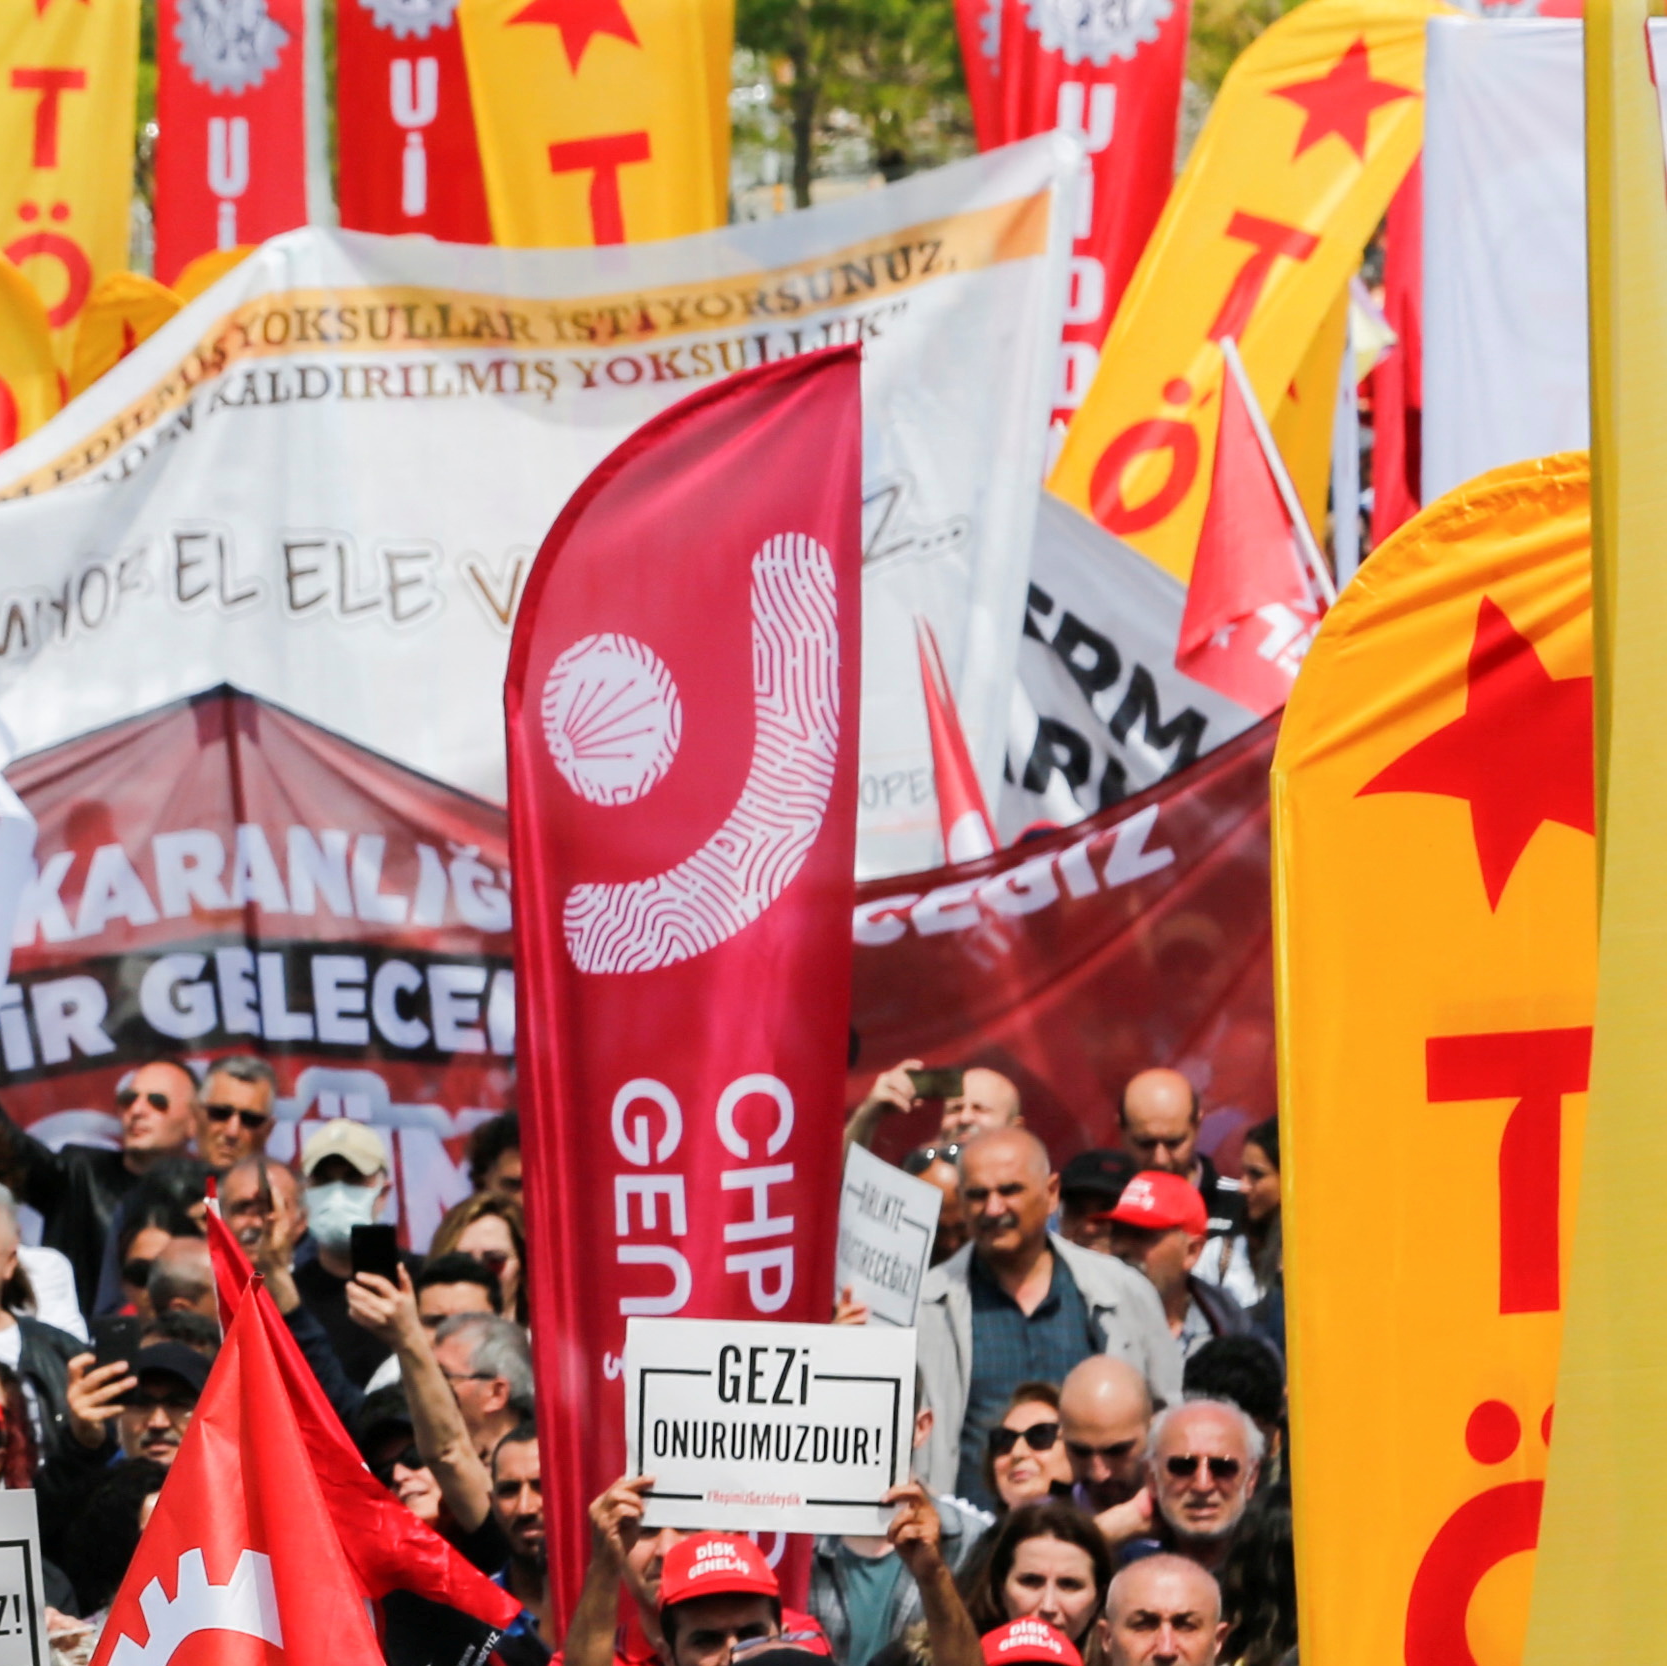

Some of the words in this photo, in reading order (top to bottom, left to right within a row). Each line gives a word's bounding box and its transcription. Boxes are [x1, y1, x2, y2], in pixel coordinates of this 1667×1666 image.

[714, 1073, 795, 1312] CHP
[716, 1346, 811, 1406] GEZİ
[651, 1417, 882, 1467] ONURUMUZDUR!
[687, 1556, 750, 1580] GENEL-İŞ
[695, 1540, 736, 1561] DİSK
[1009, 1617, 1048, 1639] DİSK
